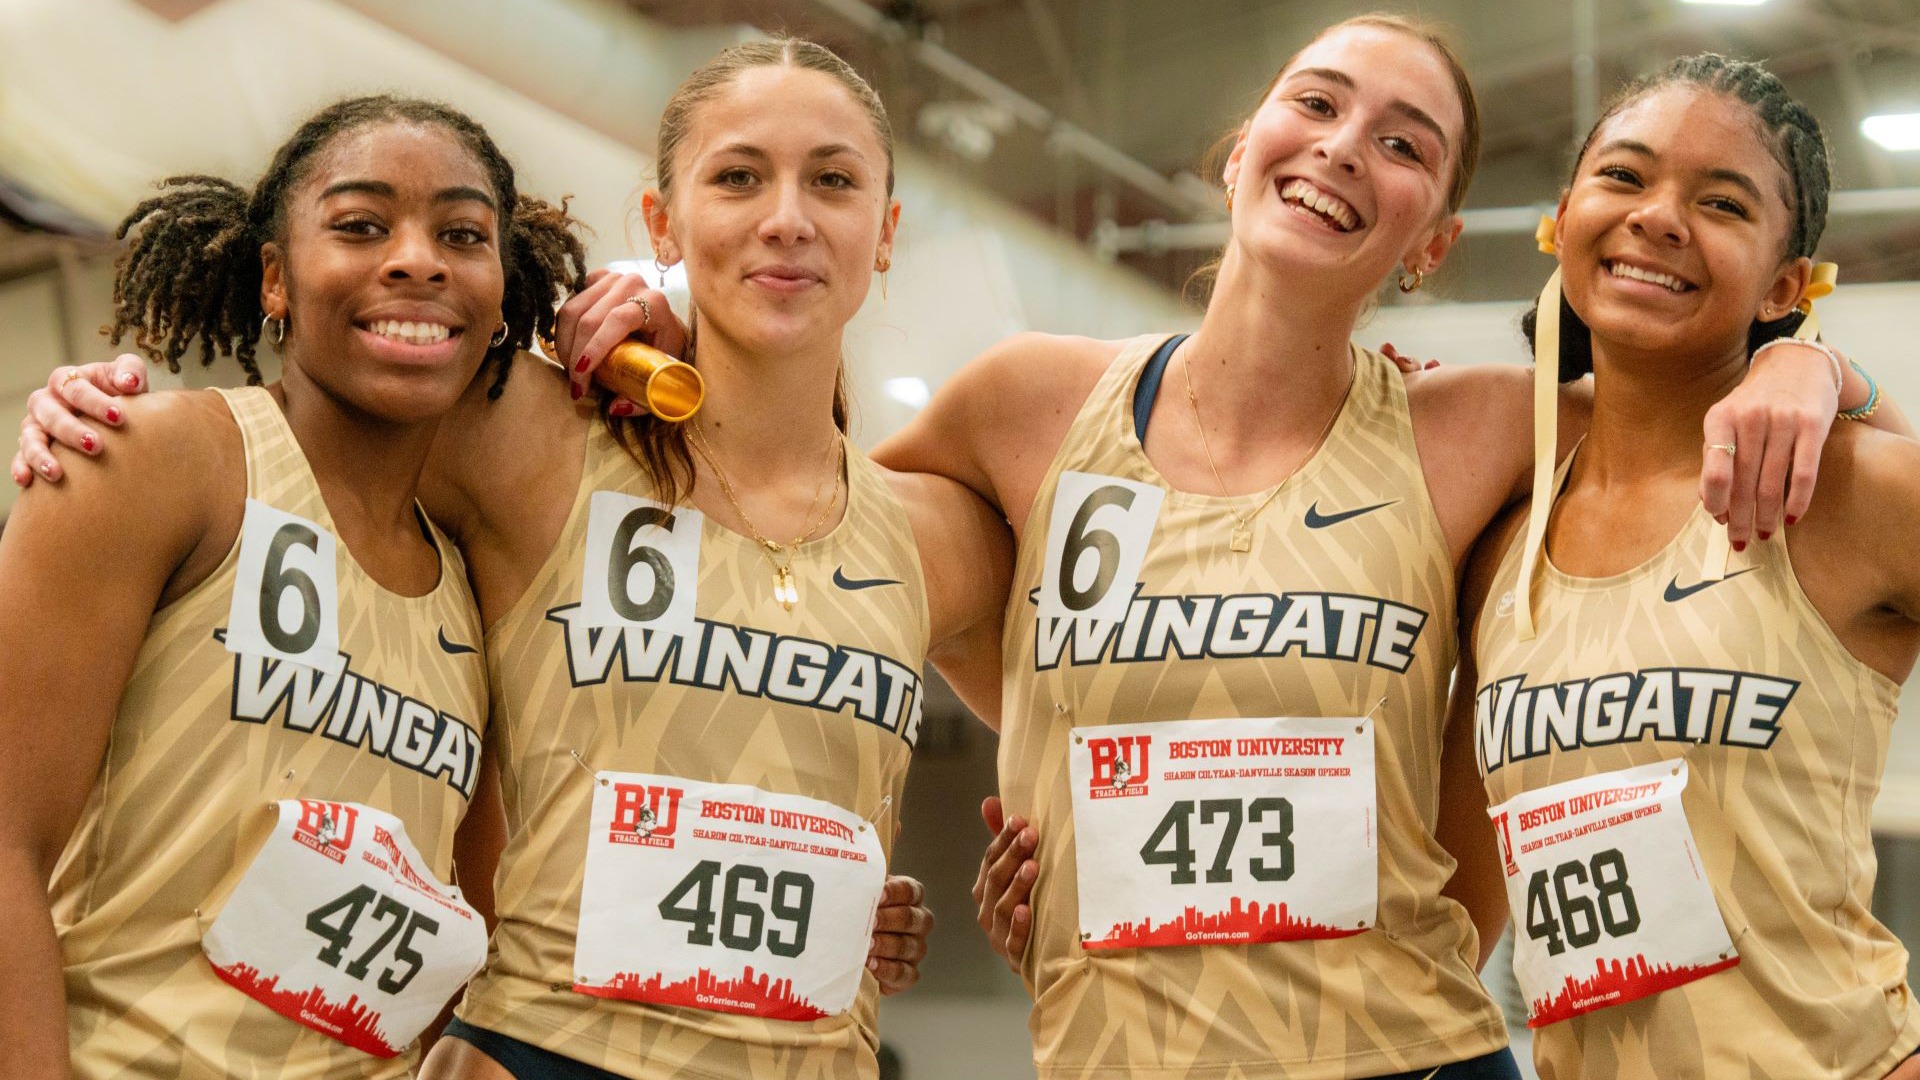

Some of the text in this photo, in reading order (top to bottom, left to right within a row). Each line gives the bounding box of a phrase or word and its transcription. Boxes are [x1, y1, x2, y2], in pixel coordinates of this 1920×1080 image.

[607, 506, 677, 622] 6
[1058, 484, 1137, 612] 6
[258, 522, 322, 654] 6
[1029, 582, 1430, 675] WINGATE
[1087, 735, 1152, 787] BU
[1163, 767, 1351, 781] SHARON COLYEAR-DANVILLE SEASON OPENER
[1168, 738, 1345, 760] BOSTON UNIVERSITY
[610, 782, 684, 837] BU
[1094, 788, 1117, 798] TRACK
[1124, 786, 1144, 796] FIELD
[1518, 781, 1662, 832] BOSTON UNIVERSITY
[297, 799, 359, 851] BU
[614, 834, 639, 844] TRACK
[648, 836, 670, 847] FIELD
[692, 829, 868, 863] SHARON COLYEAR-DANVILLE SEASON OPENER
[700, 800, 856, 844] BOSTON UNIVERSITY
[1139, 797, 1295, 885] 473
[1520, 839, 1543, 855] SHARON
[1608, 811, 1634, 827] SEASON
[1635, 803, 1662, 820] OPENER
[657, 860, 815, 958] 469
[1526, 848, 1641, 957] 468
[306, 883, 440, 996] 475
[1185, 931, 1250, 941] GoTerriers.com
